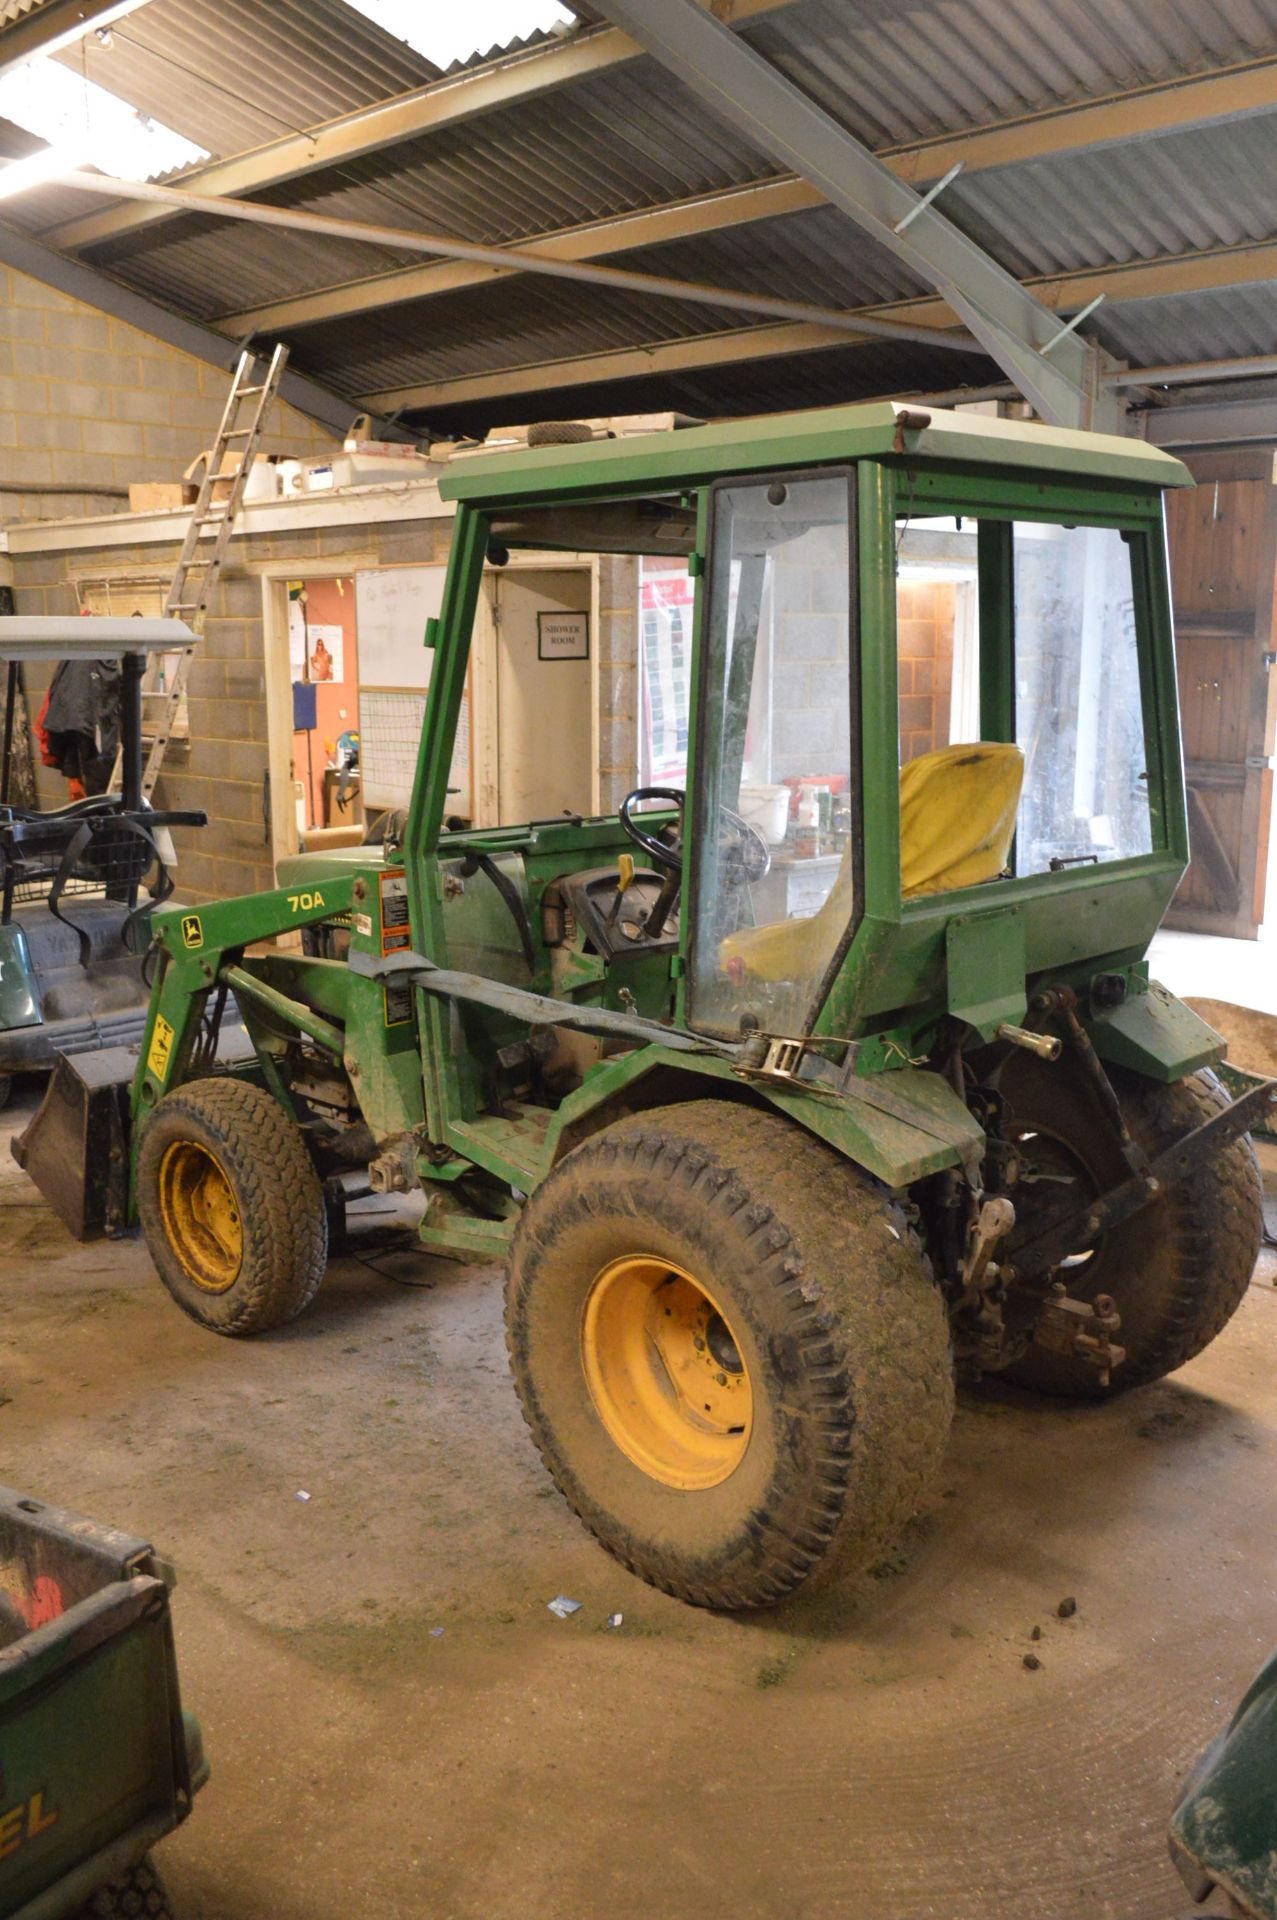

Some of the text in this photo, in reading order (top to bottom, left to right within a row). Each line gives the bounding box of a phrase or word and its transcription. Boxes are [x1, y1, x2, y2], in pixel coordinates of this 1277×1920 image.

[545, 624, 580, 633] SHOWER
[551, 636, 575, 645] ROOM
[287, 891, 325, 913] 70A
